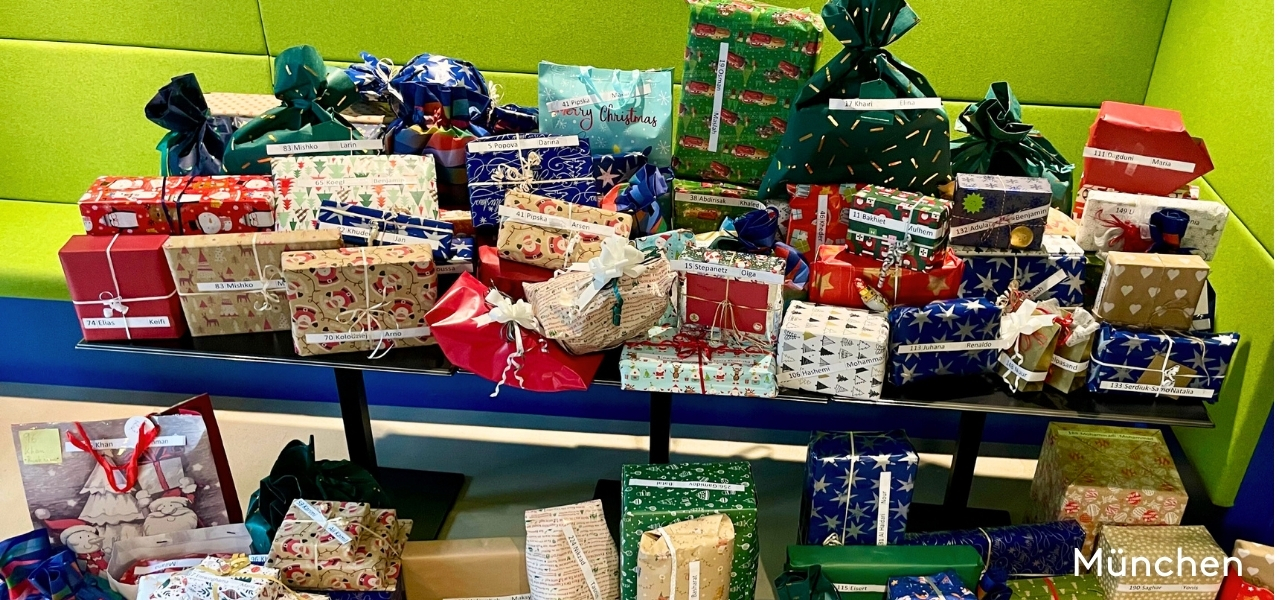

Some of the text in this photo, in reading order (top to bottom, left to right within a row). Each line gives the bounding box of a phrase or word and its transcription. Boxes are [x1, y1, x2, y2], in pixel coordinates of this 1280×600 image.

[599, 104, 658, 127] Christmas
[283, 141, 357, 152] 83 Mishko Larin
[494, 142, 518, 150] Popova
[538, 138, 560, 146] Darina
[1151, 158, 1172, 167] Maria
[739, 200, 760, 208] Khaled
[526, 212, 548, 223] Pipska
[571, 222, 590, 231] Arsen
[956, 227, 968, 235] 132
[1016, 208, 1047, 221] Benjamin
[694, 264, 728, 274] Stepanetz
[741, 269, 756, 278] Olga
[215, 281, 254, 290] 83 Mishko
[98, 318, 115, 326] Elias
[384, 330, 402, 338] Arno
[789, 372, 801, 380] 106
[801, 366, 830, 377] Hashemi
[1110, 382, 1194, 395] 133 Natalia
[568, 535, 576, 547] 224
[573, 547, 586, 566] Nikzad
